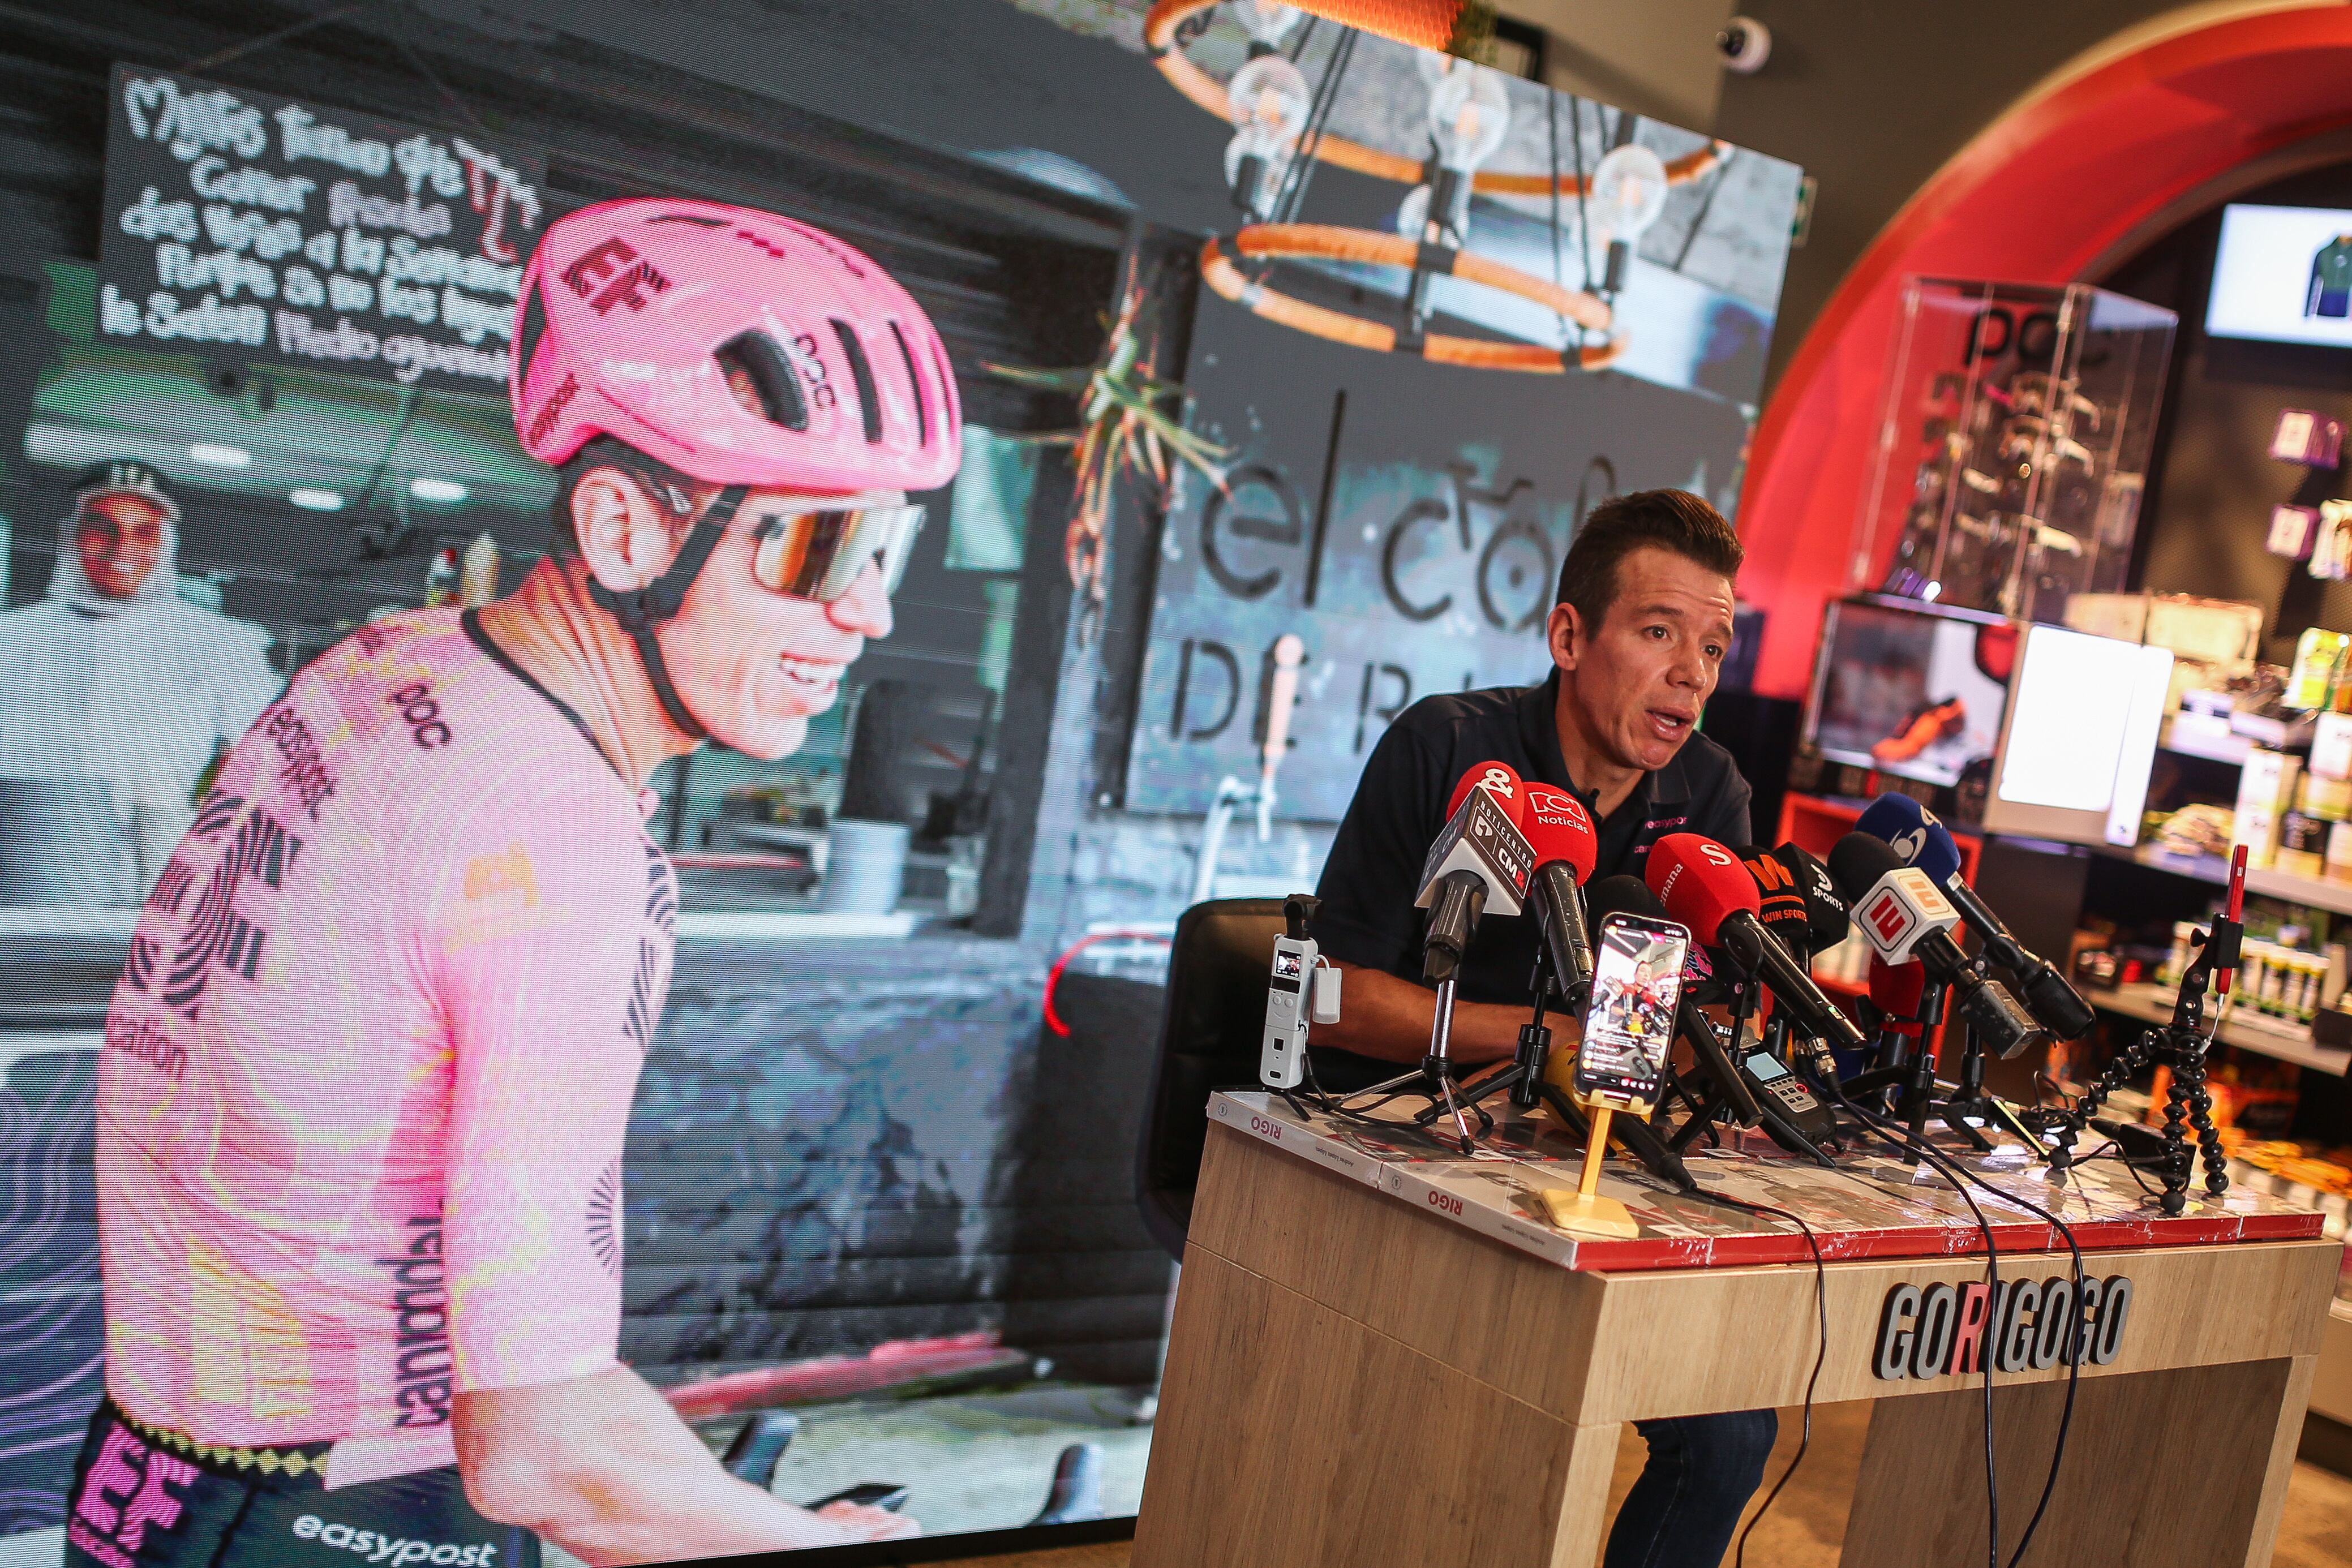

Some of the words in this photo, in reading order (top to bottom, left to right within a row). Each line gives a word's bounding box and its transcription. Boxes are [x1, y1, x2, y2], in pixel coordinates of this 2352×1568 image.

[1479, 800, 1533, 869] NOTICENTRO
[1537, 815, 1589, 835] Noticias
[1699, 843, 1733, 866] S
[1812, 886, 1844, 912] SPORTS
[1761, 910, 1783, 923] WIN
[1783, 909, 1808, 922] SPORTS
[1250, 1116, 1282, 1141] RIGO
[1427, 1189, 1464, 1217] RIGO
[292, 1513, 500, 1568] easypost
